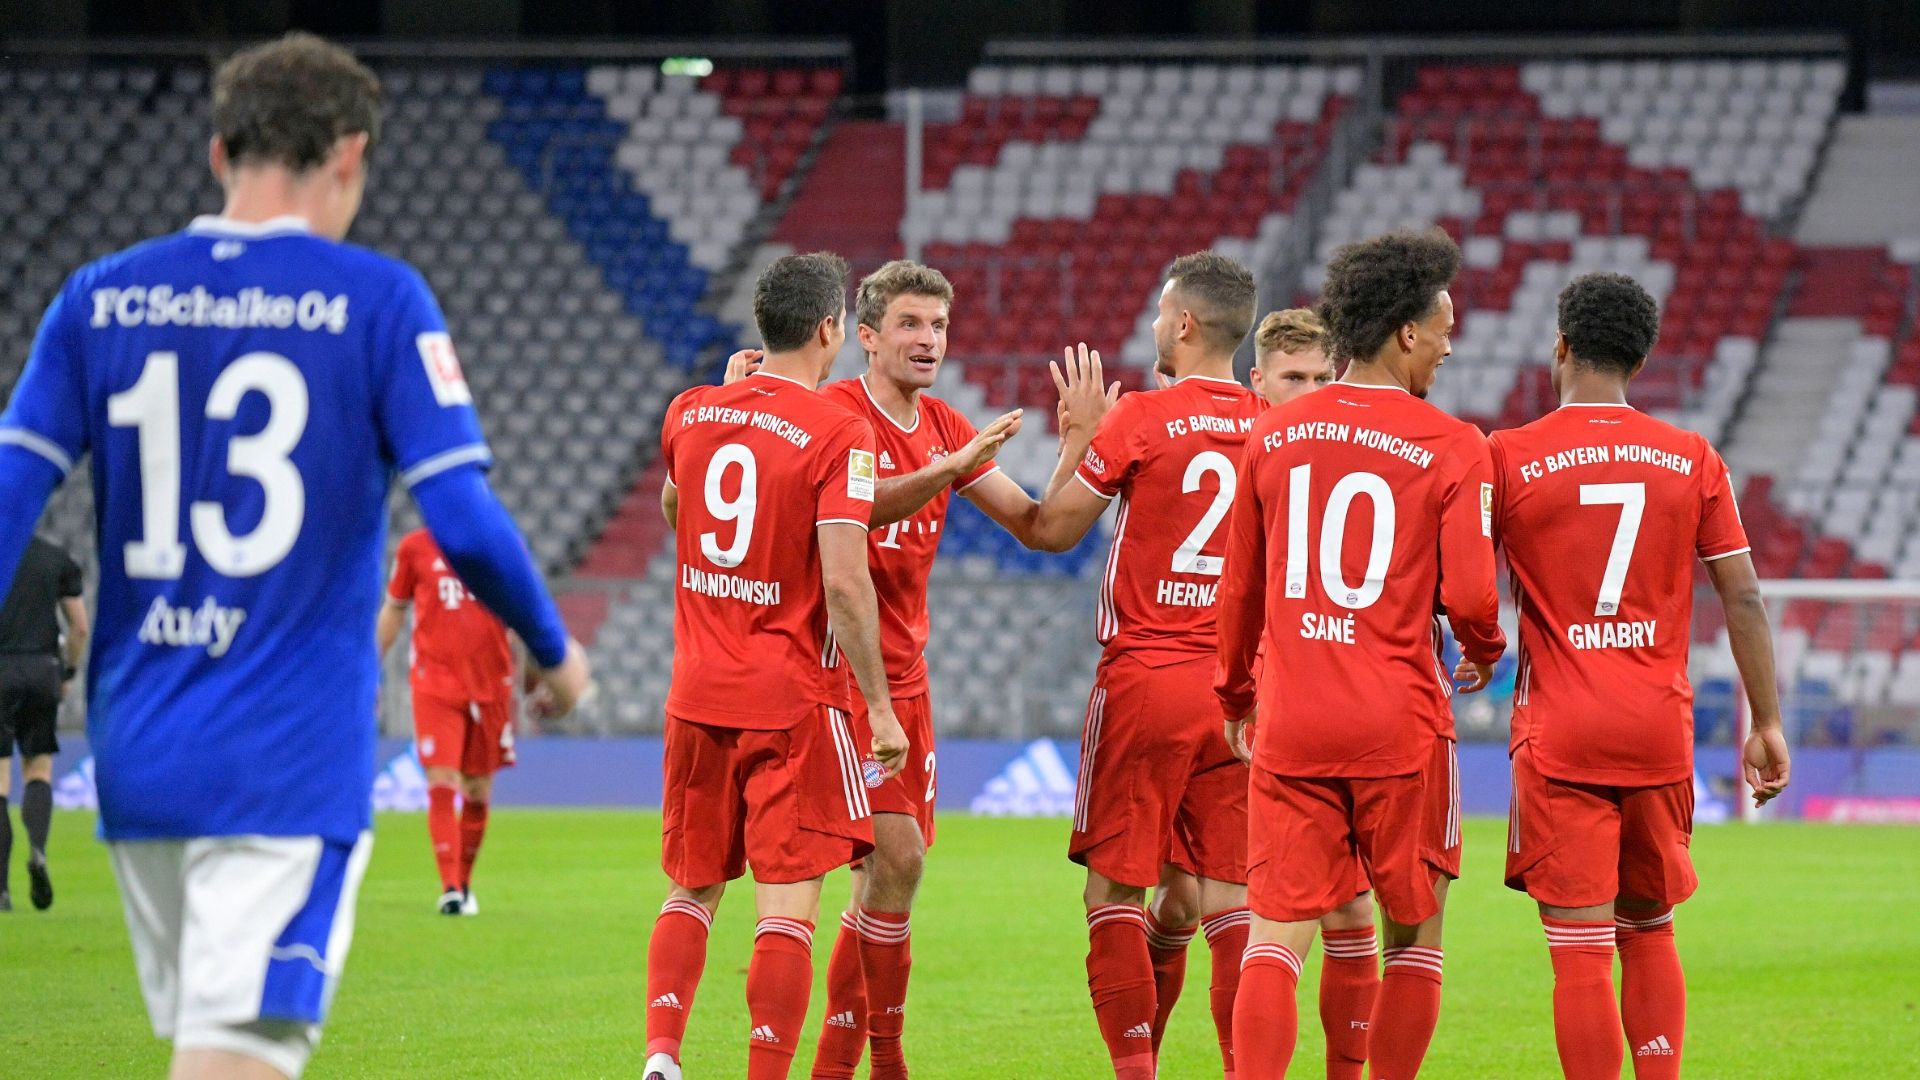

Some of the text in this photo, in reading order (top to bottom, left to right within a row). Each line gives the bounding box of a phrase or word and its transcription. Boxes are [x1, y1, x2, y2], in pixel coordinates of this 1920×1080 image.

[682, 406, 812, 450] FC BAYERN MÜNCHEN
[1166, 415, 1255, 438] FC BAYERN M
[1263, 421, 1434, 469] FC BAYERN MÜNCHEN
[107, 351, 309, 579] 13
[1520, 445, 1693, 483] FC BAYERN MÜNCHEN
[700, 443, 757, 568] 9
[1285, 463, 1396, 610] 10
[1579, 482, 1646, 617] 7
[1156, 579, 1218, 608] HERNA
[1299, 612, 1356, 645] SANÉ
[1567, 620, 1656, 650] GNABRY
[826, 1018, 857, 1030] adidas
[1637, 1047, 1674, 1057] adidas
